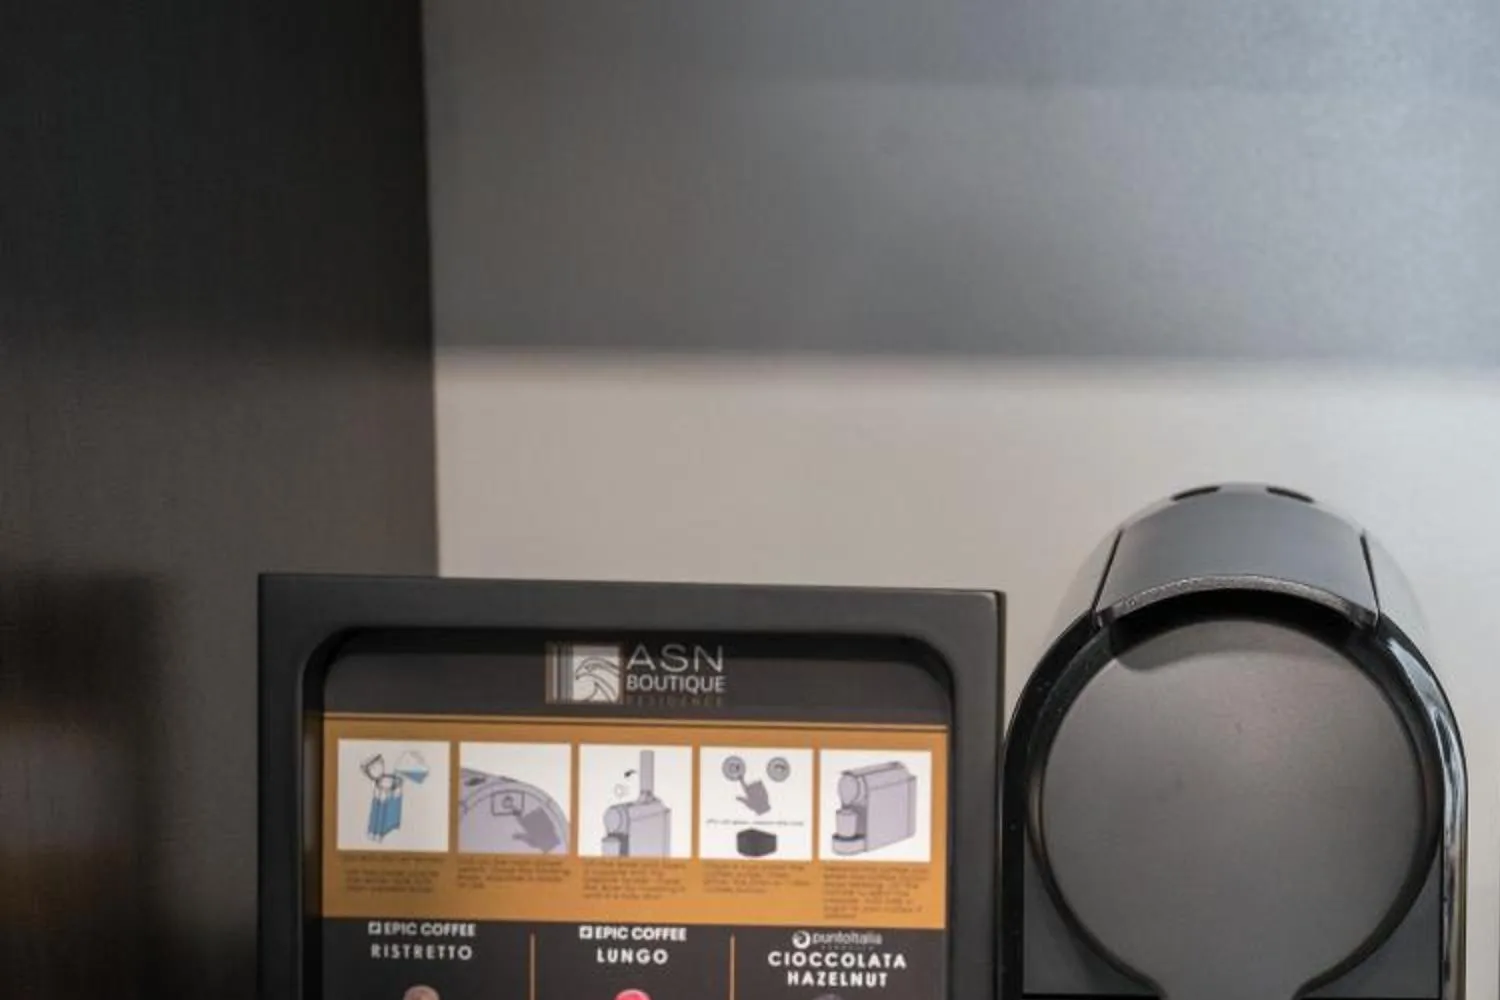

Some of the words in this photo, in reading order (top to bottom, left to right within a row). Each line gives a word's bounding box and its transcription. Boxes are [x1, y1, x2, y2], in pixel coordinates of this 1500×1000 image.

[626, 644, 724, 673] ASN
[626, 675, 727, 694] BOUTIQUE
[384, 922, 417, 936] EPIC
[420, 922, 476, 937] COFFEE
[595, 926, 629, 940] EPIC
[632, 927, 688, 941] COFFEE
[370, 944, 473, 960] RISTRETTO
[597, 948, 669, 965] LUNGO
[767, 951, 908, 969] CIOCCOLATA
[787, 971, 888, 988] HAZELNUT
